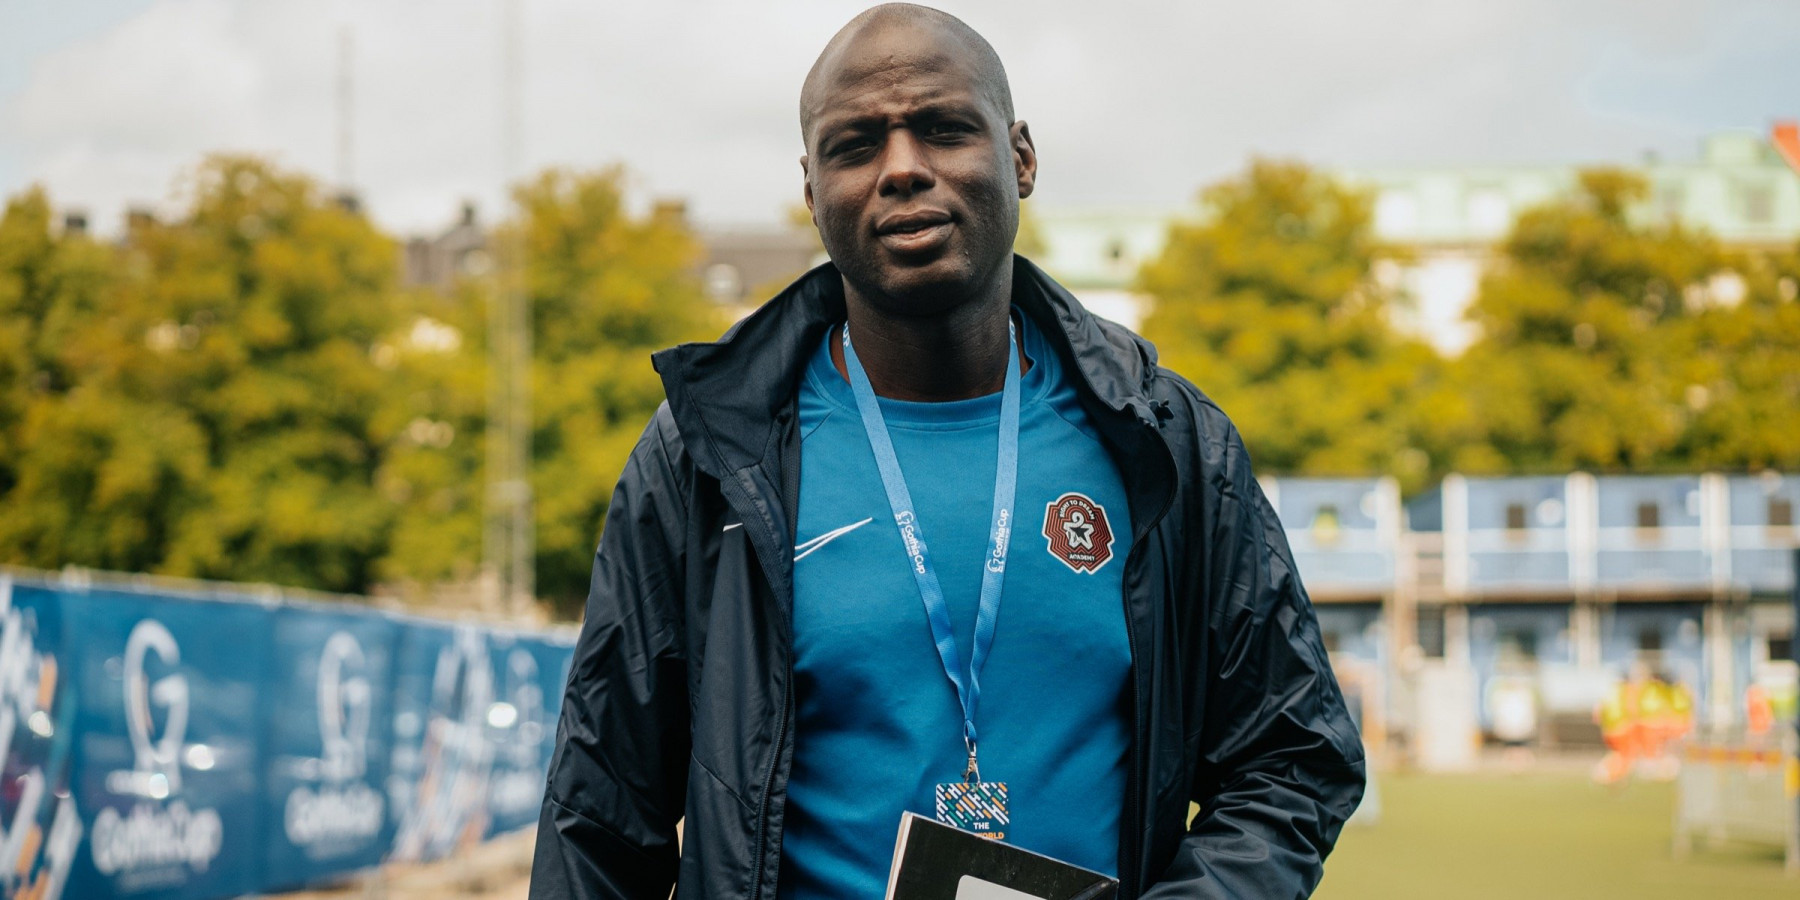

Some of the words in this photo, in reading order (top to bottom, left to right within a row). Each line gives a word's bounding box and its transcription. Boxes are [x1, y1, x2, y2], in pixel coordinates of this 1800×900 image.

[997, 508, 1009, 528] Cup
[1079, 501, 1095, 520] DREAM
[905, 525, 919, 556] Gothia
[914, 554, 926, 574] Cup
[992, 527, 1006, 558] Gothia
[1069, 553, 1095, 561] ACADEMY
[973, 822, 990, 830] THE
